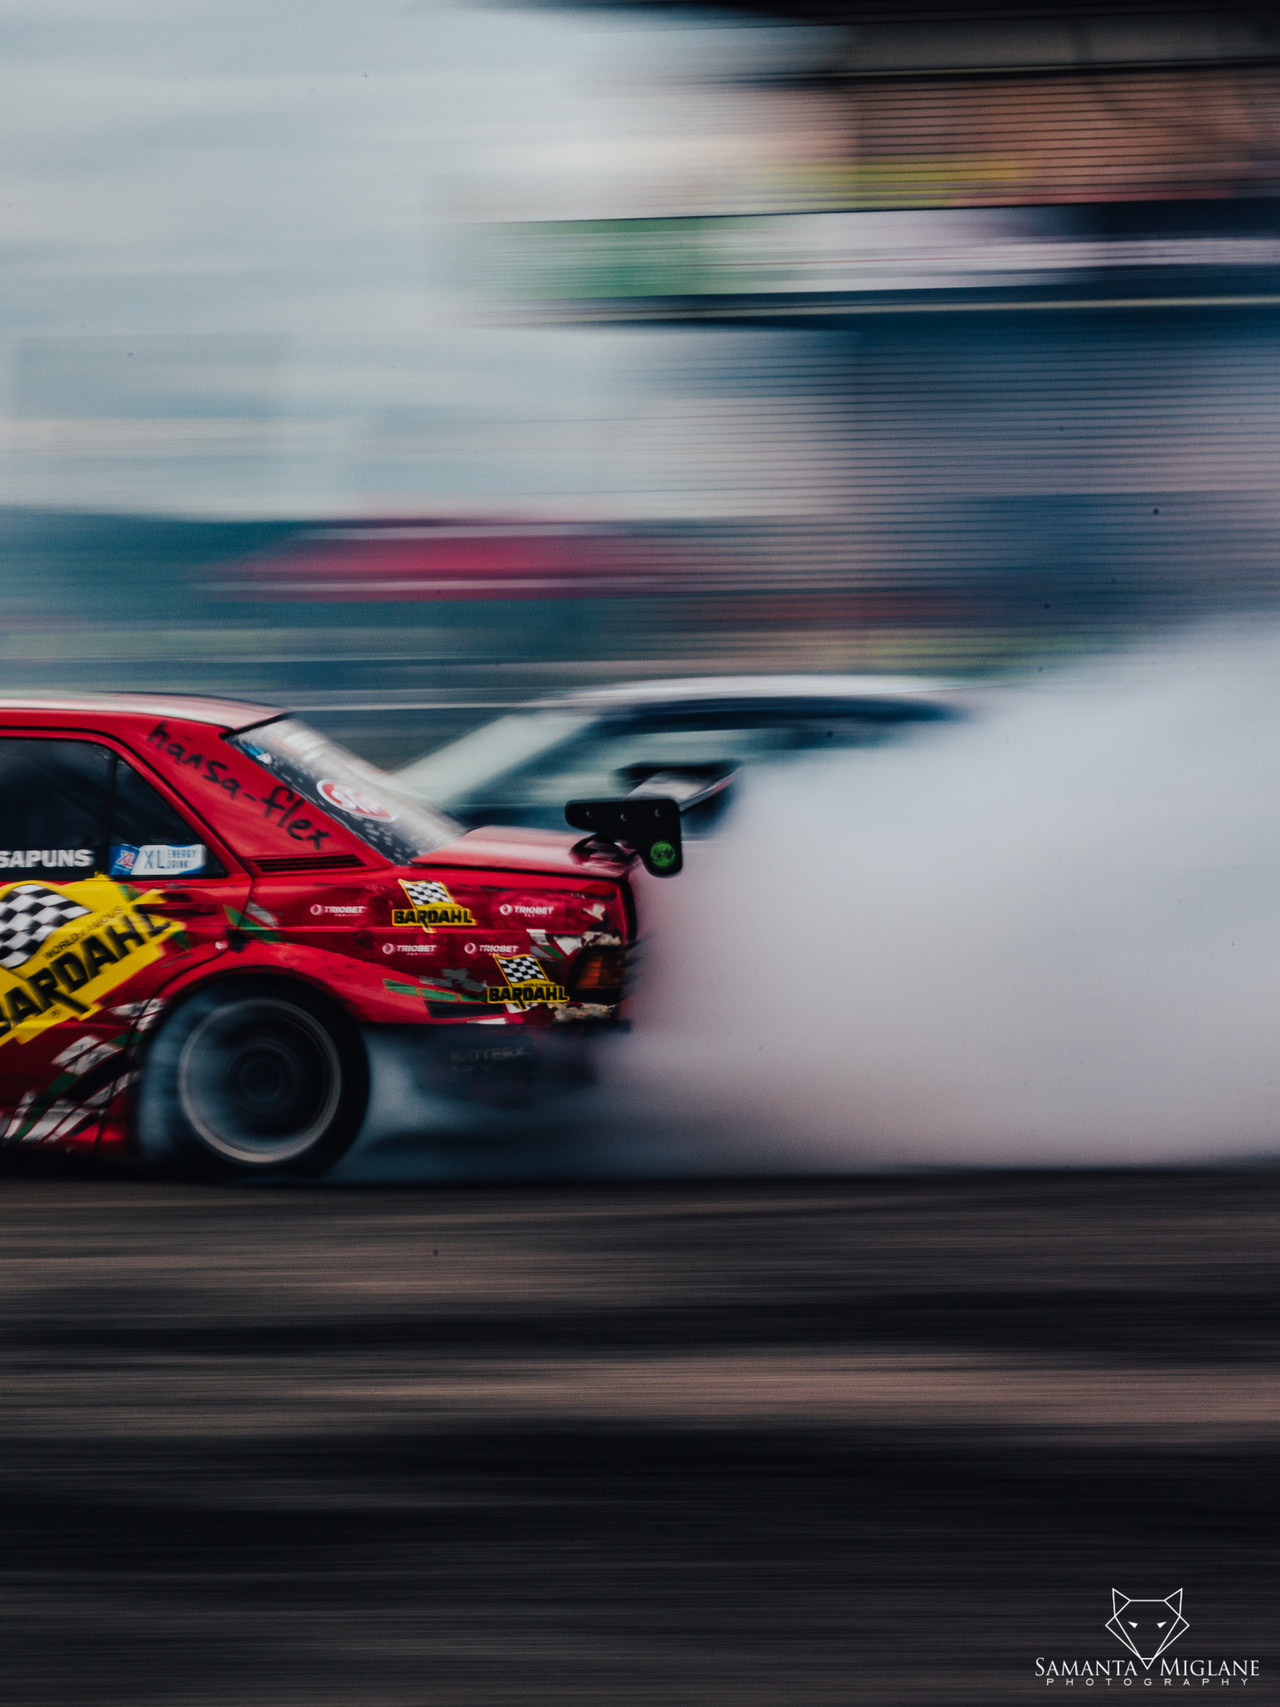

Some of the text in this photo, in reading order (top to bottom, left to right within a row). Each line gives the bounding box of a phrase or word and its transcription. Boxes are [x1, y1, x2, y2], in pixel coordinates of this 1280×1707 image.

[393, 908, 473, 930] BARDAHL
[514, 905, 554, 915] TRIOBET
[42, 931, 82, 961] WORLD
[478, 944, 519, 953] TRIOBET
[488, 985, 569, 1010] BARDAHL
